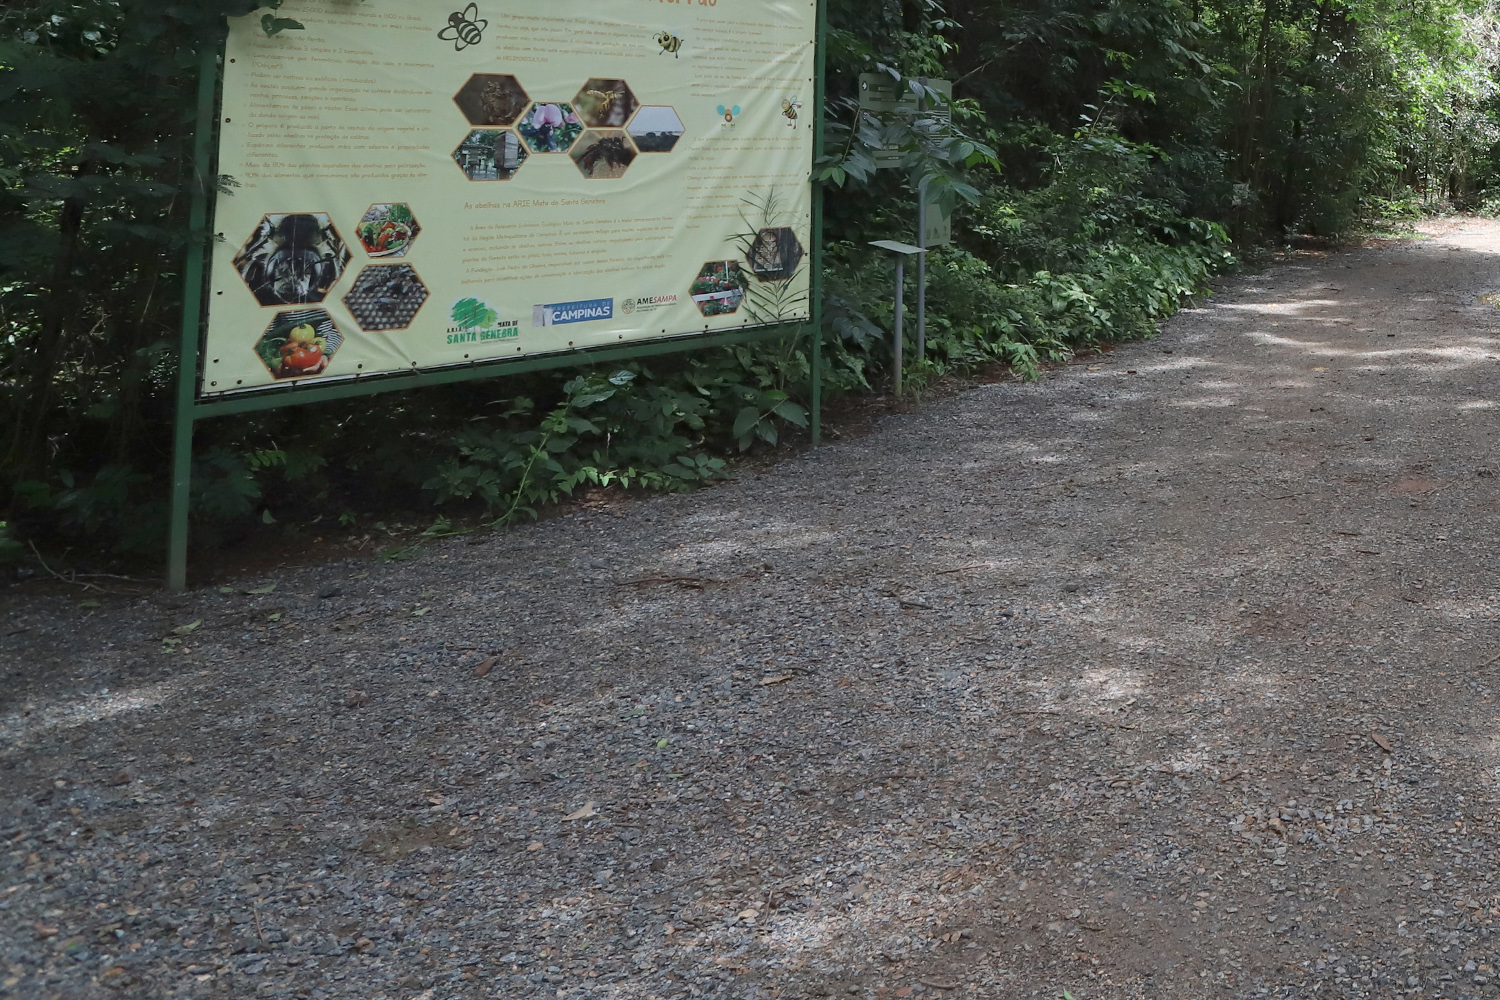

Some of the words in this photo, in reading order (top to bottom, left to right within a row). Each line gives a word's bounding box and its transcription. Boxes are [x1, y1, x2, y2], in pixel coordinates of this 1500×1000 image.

[561, 198, 578, 206] Santa
[637, 295, 677, 305] AMESAMPA
[553, 306, 610, 321] CAMPINAS
[447, 332, 476, 345] SANTA
[480, 327, 519, 340] GENEBRA
